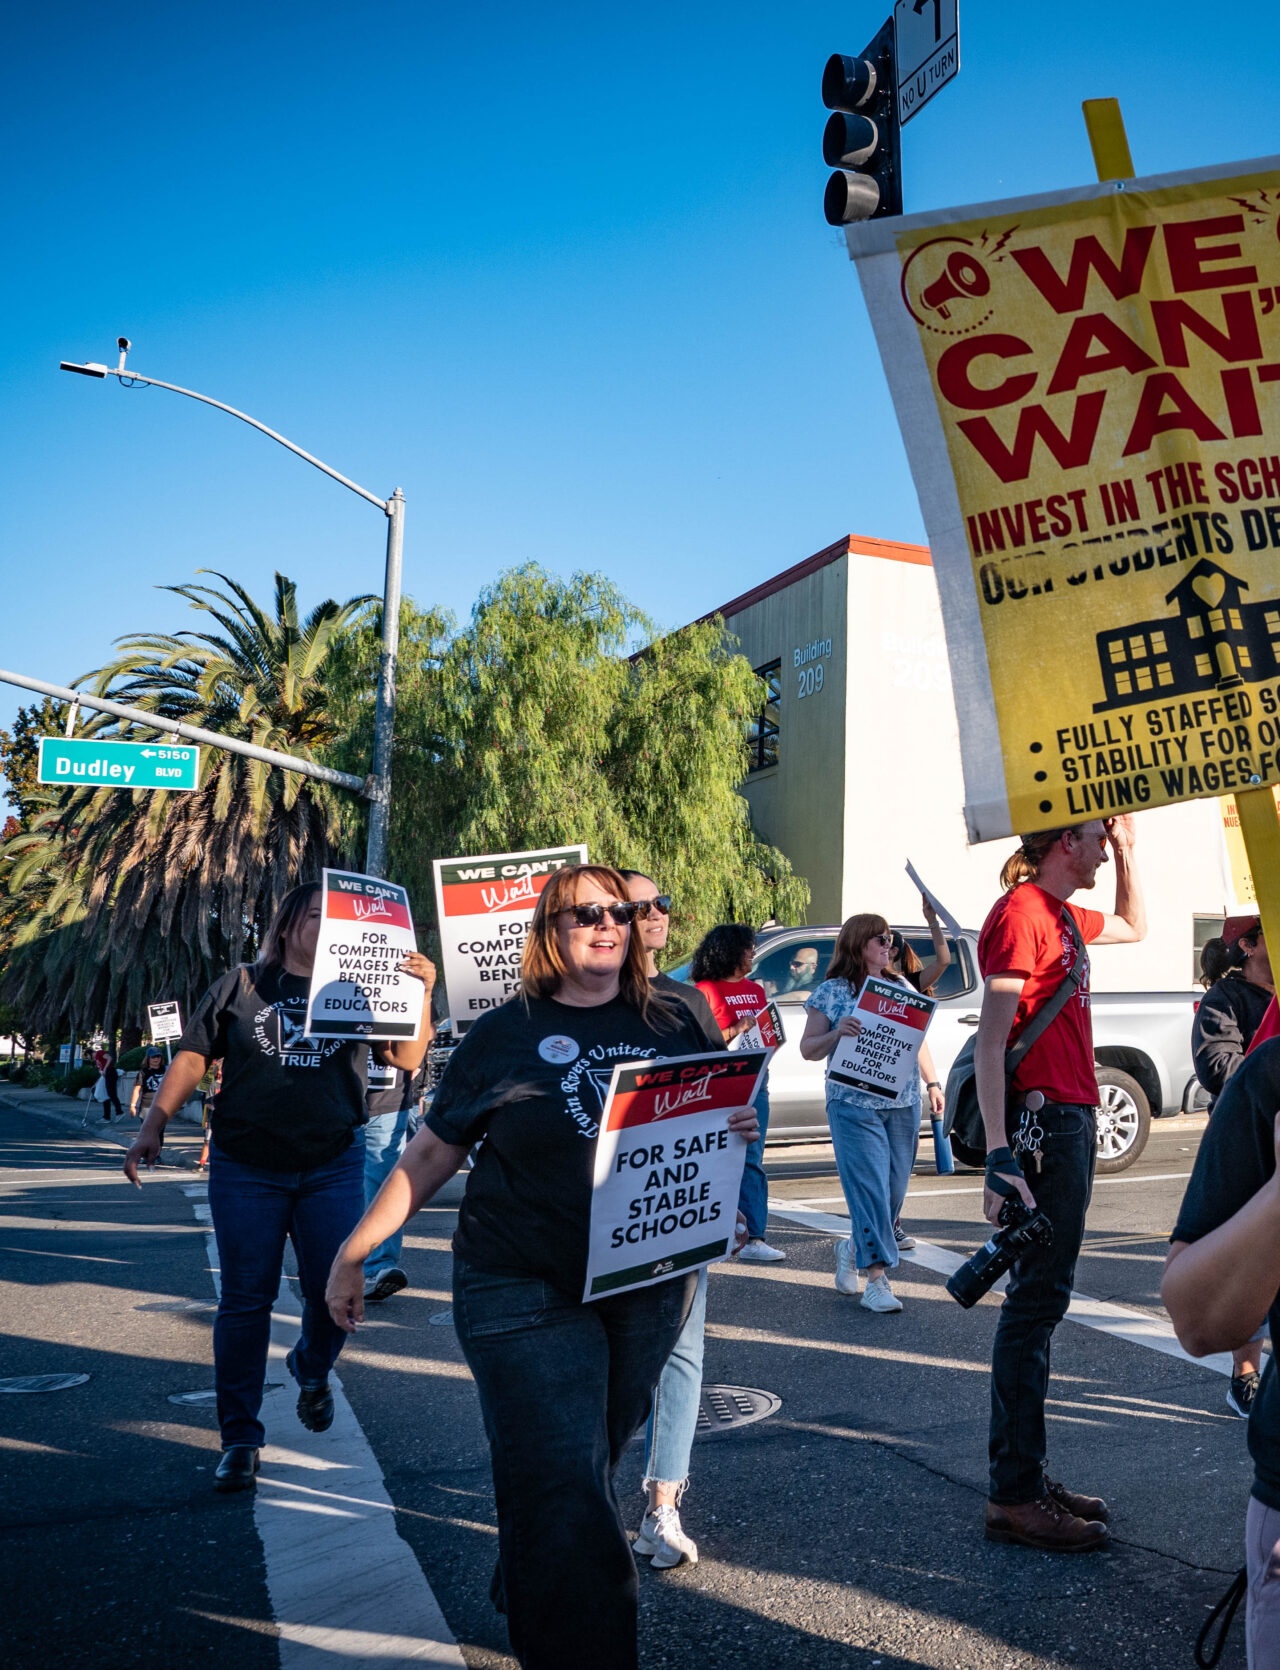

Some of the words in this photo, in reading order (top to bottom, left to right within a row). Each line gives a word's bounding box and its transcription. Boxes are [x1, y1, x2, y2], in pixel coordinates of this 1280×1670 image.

[902, 87, 915, 111] NO
[917, 71, 926, 97] U
[929, 47, 954, 84] TURN
[1010, 214, 1259, 314] WE
[967, 488, 1089, 558] INVEST
[1099, 478, 1141, 527] IN
[1145, 462, 1210, 515] THE
[794, 637, 833, 668] Building
[797, 663, 825, 699] 209
[1056, 714, 1134, 755] FULLY
[1145, 691, 1253, 736] STAFFED
[158, 750, 190, 760] 5150
[1062, 735, 1188, 783] STABILITY
[1200, 725, 1252, 758] FOR
[56, 757, 136, 782] Dudley
[155, 767, 182, 777] BLVD
[1066, 774, 1151, 815] LIVING
[1159, 757, 1254, 798] WAGES
[457, 867, 496, 880] WE
[501, 859, 567, 877] CAN'T
[339, 880, 362, 891] WE
[365, 884, 399, 900] CAN'T
[481, 874, 541, 912] Wait
[353, 894, 392, 920] Wait
[329, 943, 411, 959] COMPETITIV
[361, 932, 388, 945] FOR
[338, 957, 389, 971] WAGES
[393, 961, 402, 972] &
[338, 971, 400, 986] BENEFITS
[354, 986, 382, 998] FOR
[725, 994, 759, 1006] PROTECT
[874, 985, 892, 996] WE
[893, 992, 927, 1009] CAN'T
[254, 1001, 285, 1023] Rivers
[324, 998, 408, 1013] EDUCATORS
[770, 1008, 778, 1022] WE
[878, 1000, 908, 1018] Wait
[252, 1025, 277, 1056] Twin
[860, 1026, 913, 1052] OMPETITIVE
[876, 1023, 896, 1036] FOR
[588, 1042, 657, 1060] United
[854, 1045, 897, 1066] BENEFITS
[856, 1035, 891, 1054] WAGES
[893, 1049, 902, 1058] &
[279, 1054, 322, 1067] TRUE
[841, 1059, 897, 1084] EDUCATORS
[862, 1057, 882, 1070] FOR
[561, 1058, 591, 1093] Rivers
[635, 1070, 674, 1087] WE
[680, 1060, 749, 1080] CAN'T
[651, 1072, 712, 1121] Wait
[564, 1095, 600, 1138] Twin
[616, 1144, 664, 1173] FOR
[673, 1130, 729, 1159] SAFE
[644, 1161, 700, 1192] AND
[628, 1181, 711, 1220] STABLE
[610, 1201, 722, 1249] SCHOOLS
